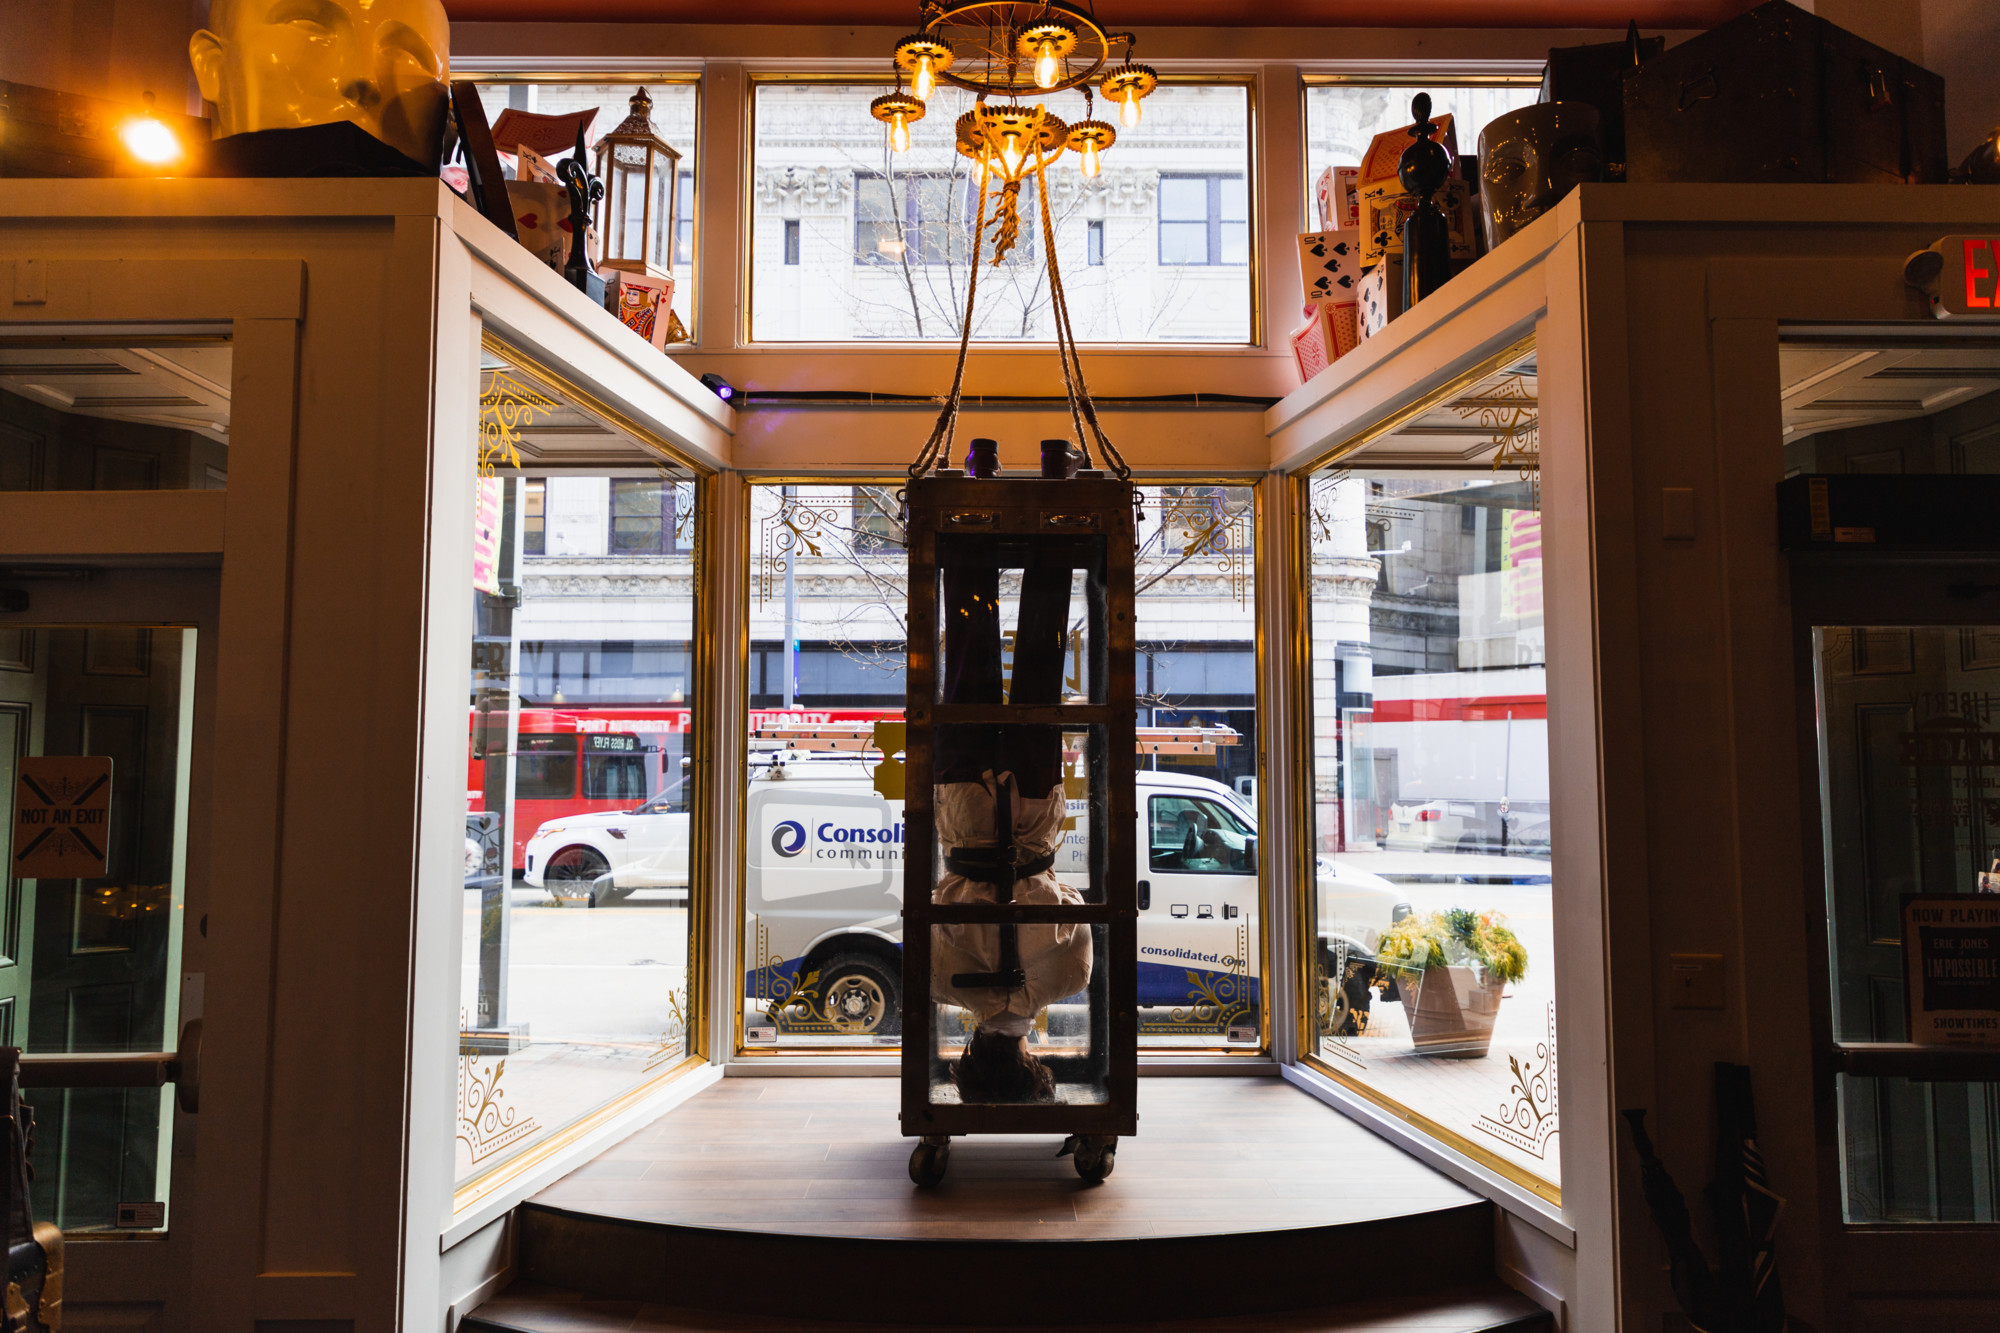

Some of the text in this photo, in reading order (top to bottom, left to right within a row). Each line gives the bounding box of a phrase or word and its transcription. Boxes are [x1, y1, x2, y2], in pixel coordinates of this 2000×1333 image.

[1365, 190, 1375, 200] K
[1304, 236, 1316, 245] 10
[1366, 251, 1377, 260] K
[661, 285, 670, 296] J
[1310, 290, 1323, 299] 10
[21, 809, 105, 824] NOT AN EXIT
[1912, 908, 2000, 922] NOW PLAYIN
[1933, 938, 1990, 949] ERIC JONES
[1140, 946, 1246, 966] consolidated.com
[1927, 958, 1999, 978] IMPOSSIBLE
[1933, 1017, 1998, 1029] SHOWTIMES
